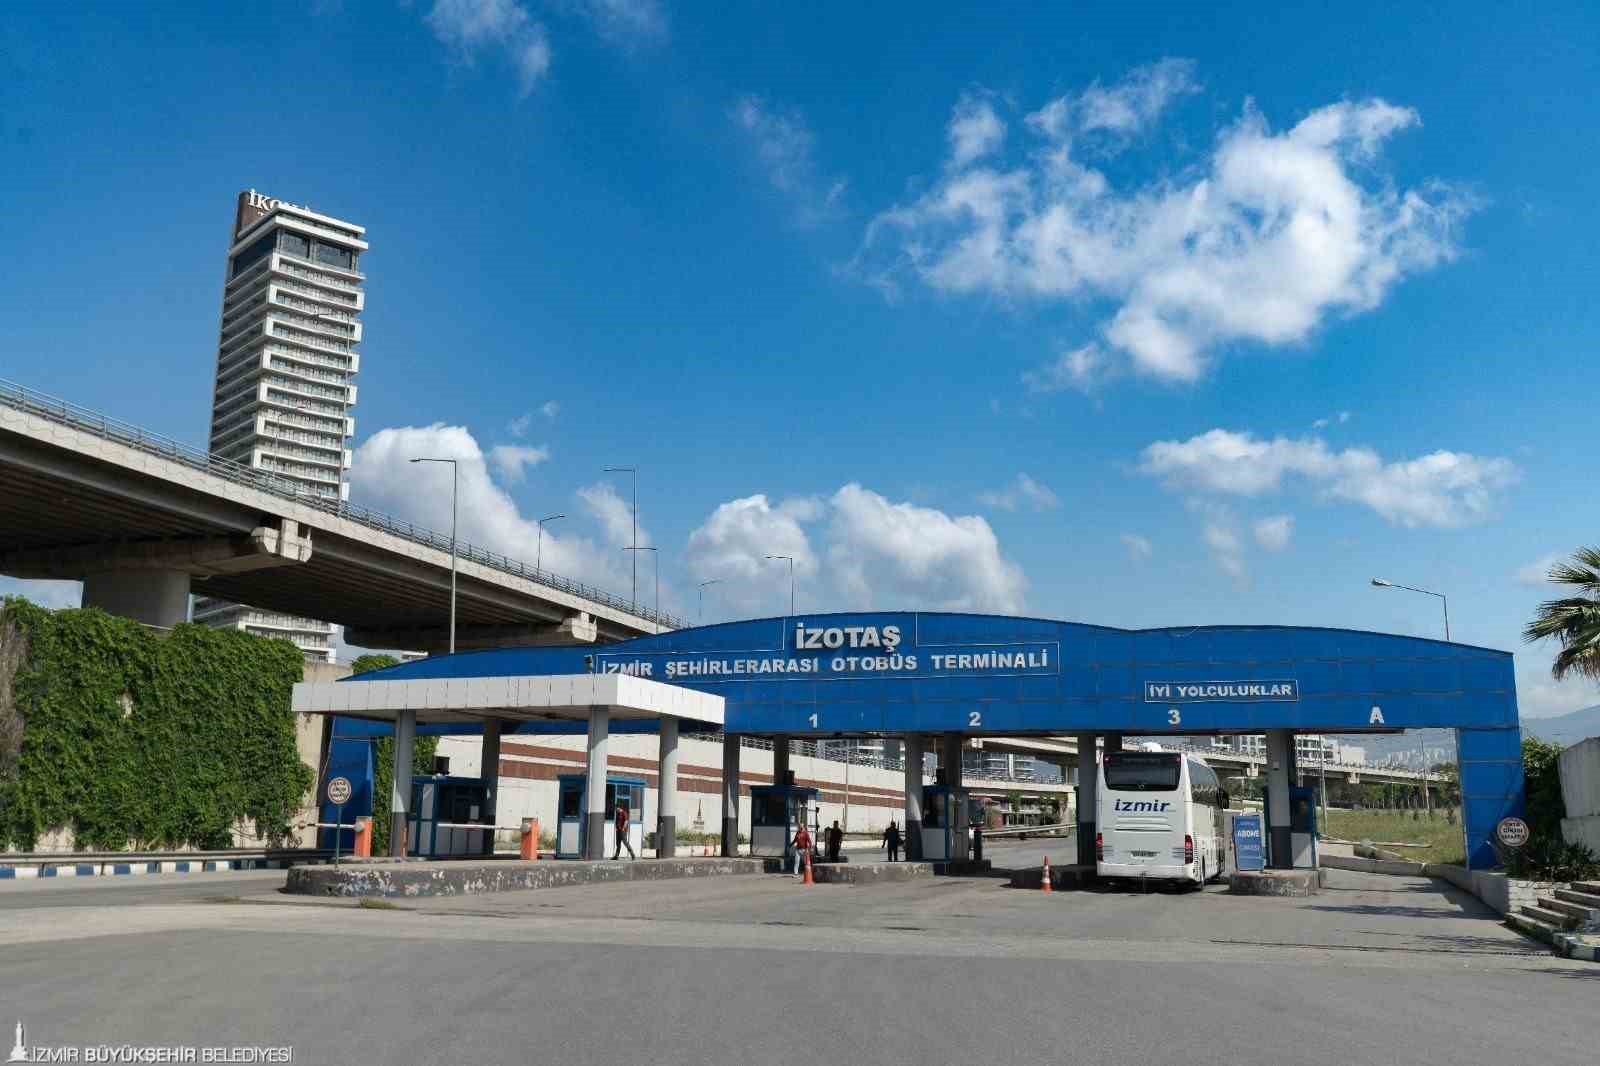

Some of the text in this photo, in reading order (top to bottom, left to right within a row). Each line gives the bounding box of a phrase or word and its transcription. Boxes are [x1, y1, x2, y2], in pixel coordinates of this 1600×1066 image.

[796, 622, 901, 652] İZOTAŞ
[602, 649, 1048, 679] İZMİR ŞEHİRLERARASI OTOBÜS TERMİNALİ
[1150, 684, 1292, 697] İYİ YOLCULUKLAR
[809, 713, 818, 728] 1
[968, 711, 981, 726] 2
[1168, 709, 1181, 724] 3
[1369, 706, 1384, 724] A
[1114, 798, 1170, 812] izmir
